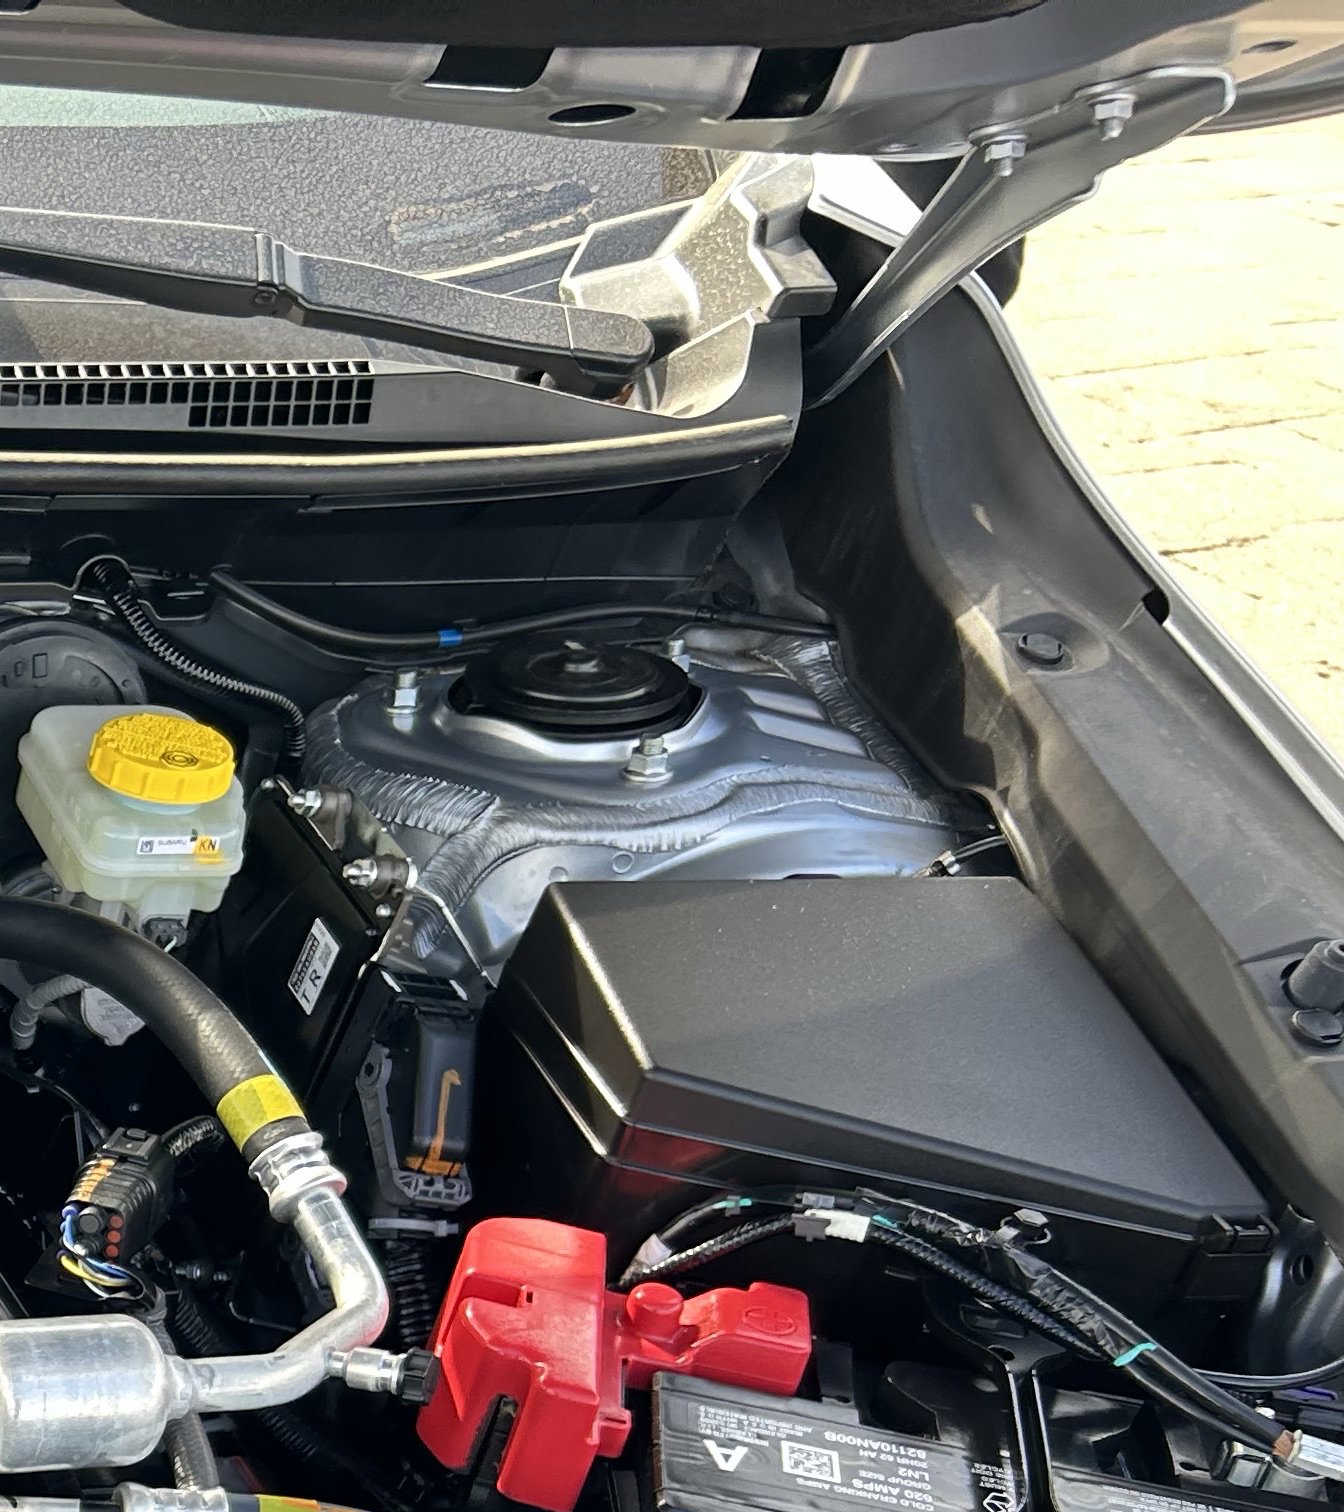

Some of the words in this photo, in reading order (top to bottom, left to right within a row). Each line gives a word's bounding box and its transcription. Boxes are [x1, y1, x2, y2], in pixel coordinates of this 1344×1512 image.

[199, 838, 217, 851] KN
[703, 1439, 749, 1472] A
[898, 1467, 929, 1481] LN2
[852, 1478, 900, 1496] AMPS
[904, 1490, 932, 1503] 620
[900, 1499, 934, 1512] COLD
